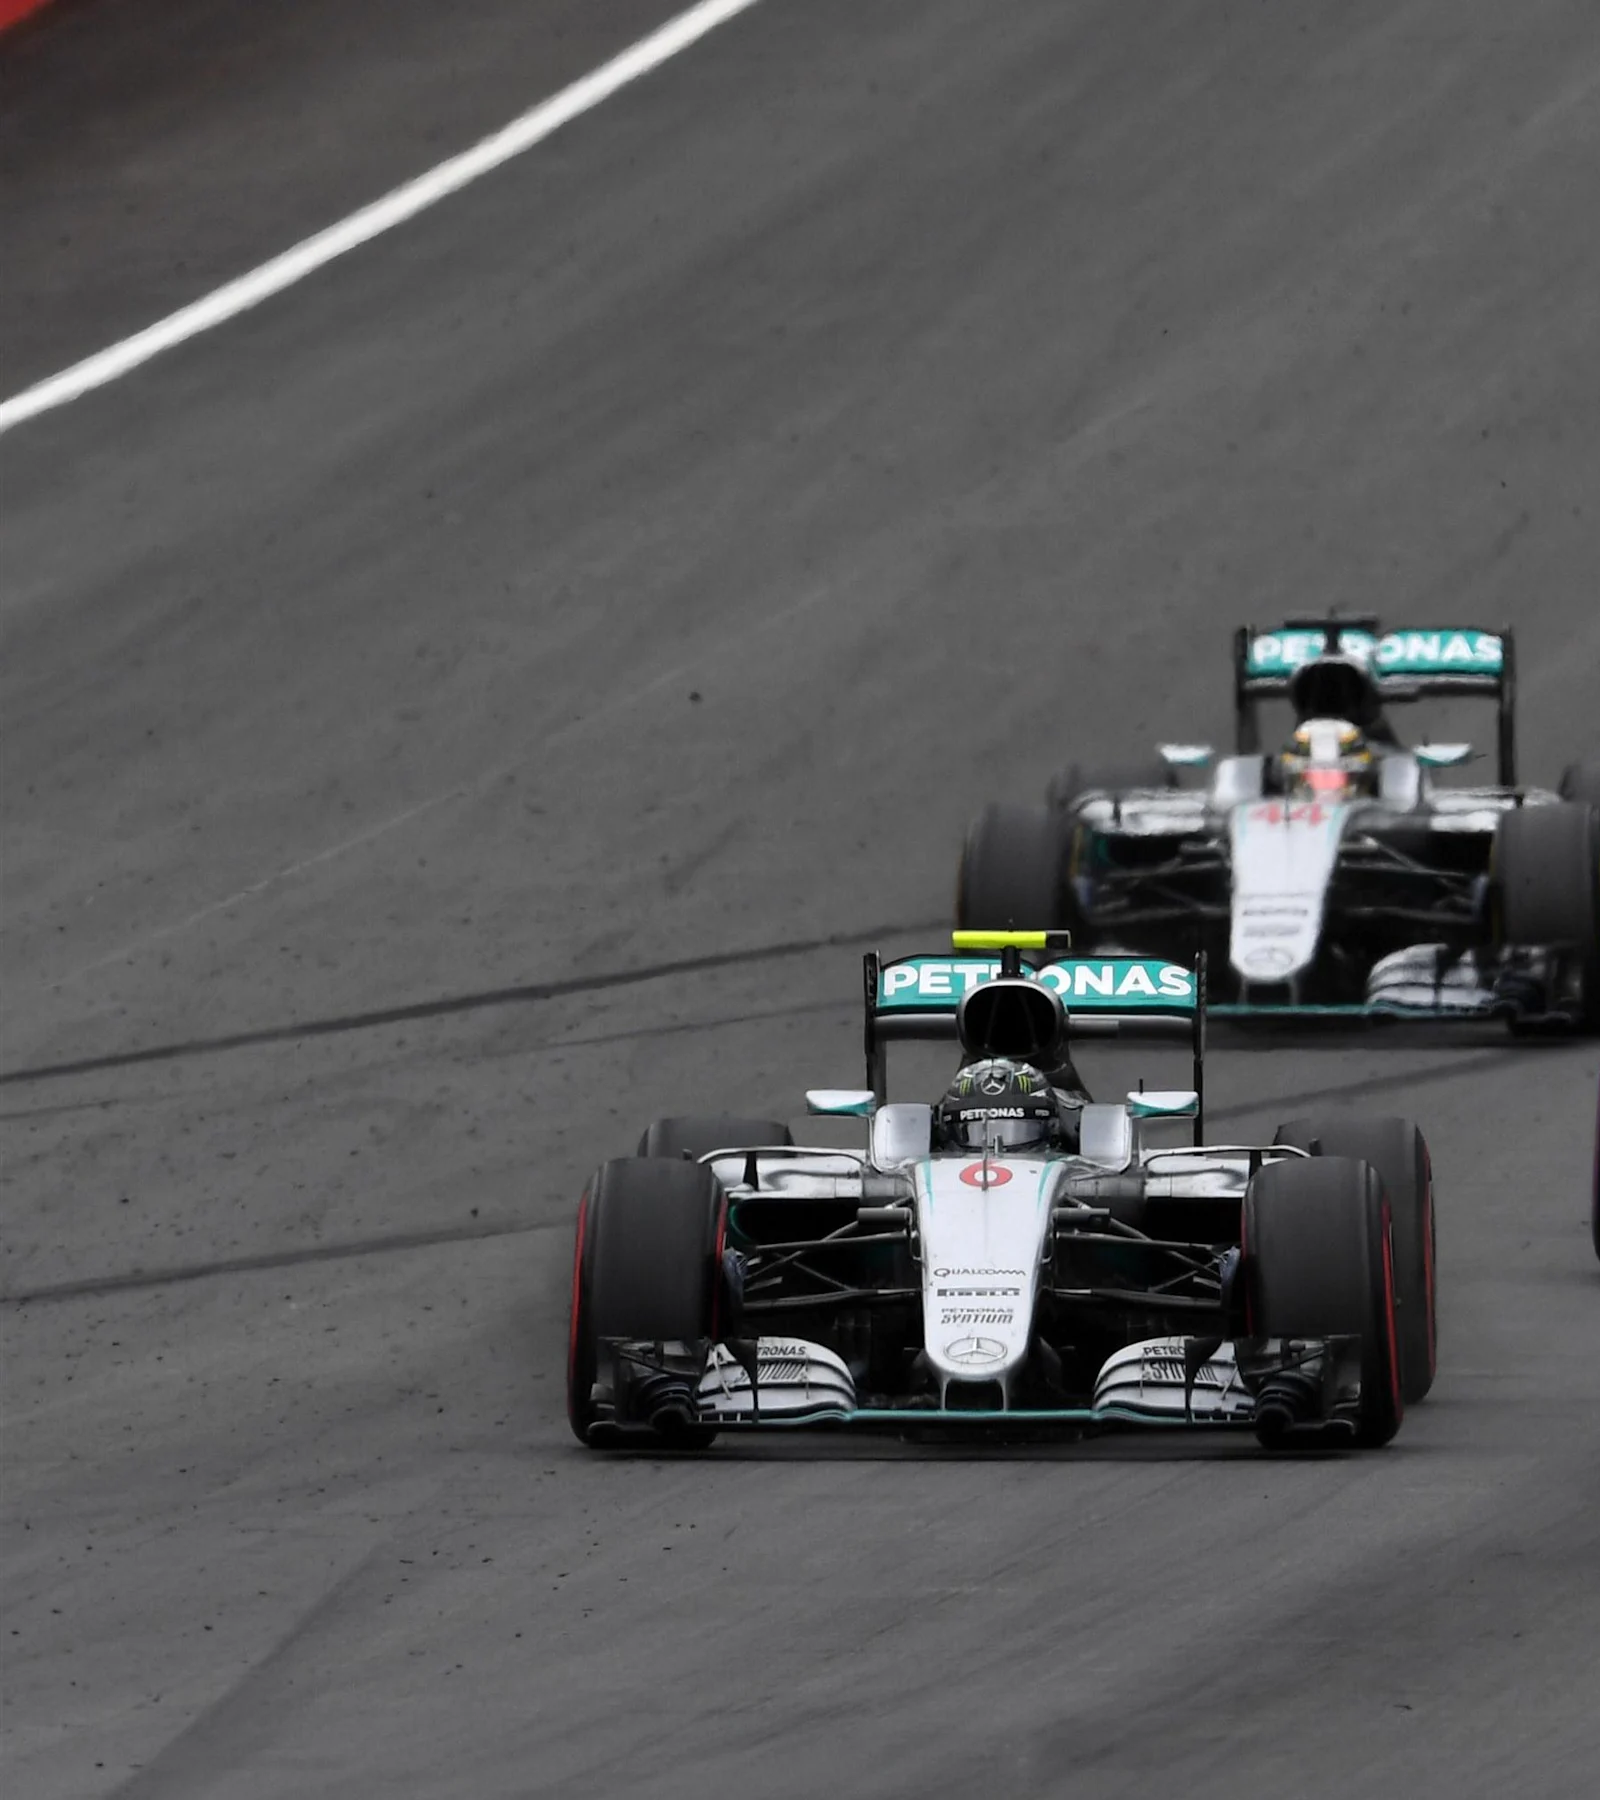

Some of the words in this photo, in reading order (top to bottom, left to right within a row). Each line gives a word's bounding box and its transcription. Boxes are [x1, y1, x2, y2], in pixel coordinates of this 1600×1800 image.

[1249, 803, 1330, 827] 44
[883, 963, 1193, 997] PETONAS
[959, 1159, 1013, 1188] 6
[934, 1268, 1026, 1277] QUALCOMM
[936, 1287, 1021, 1297] PIRELLI
[940, 1313, 1014, 1324] SYNTIUM
[1142, 1345, 1186, 1356] PETRO
